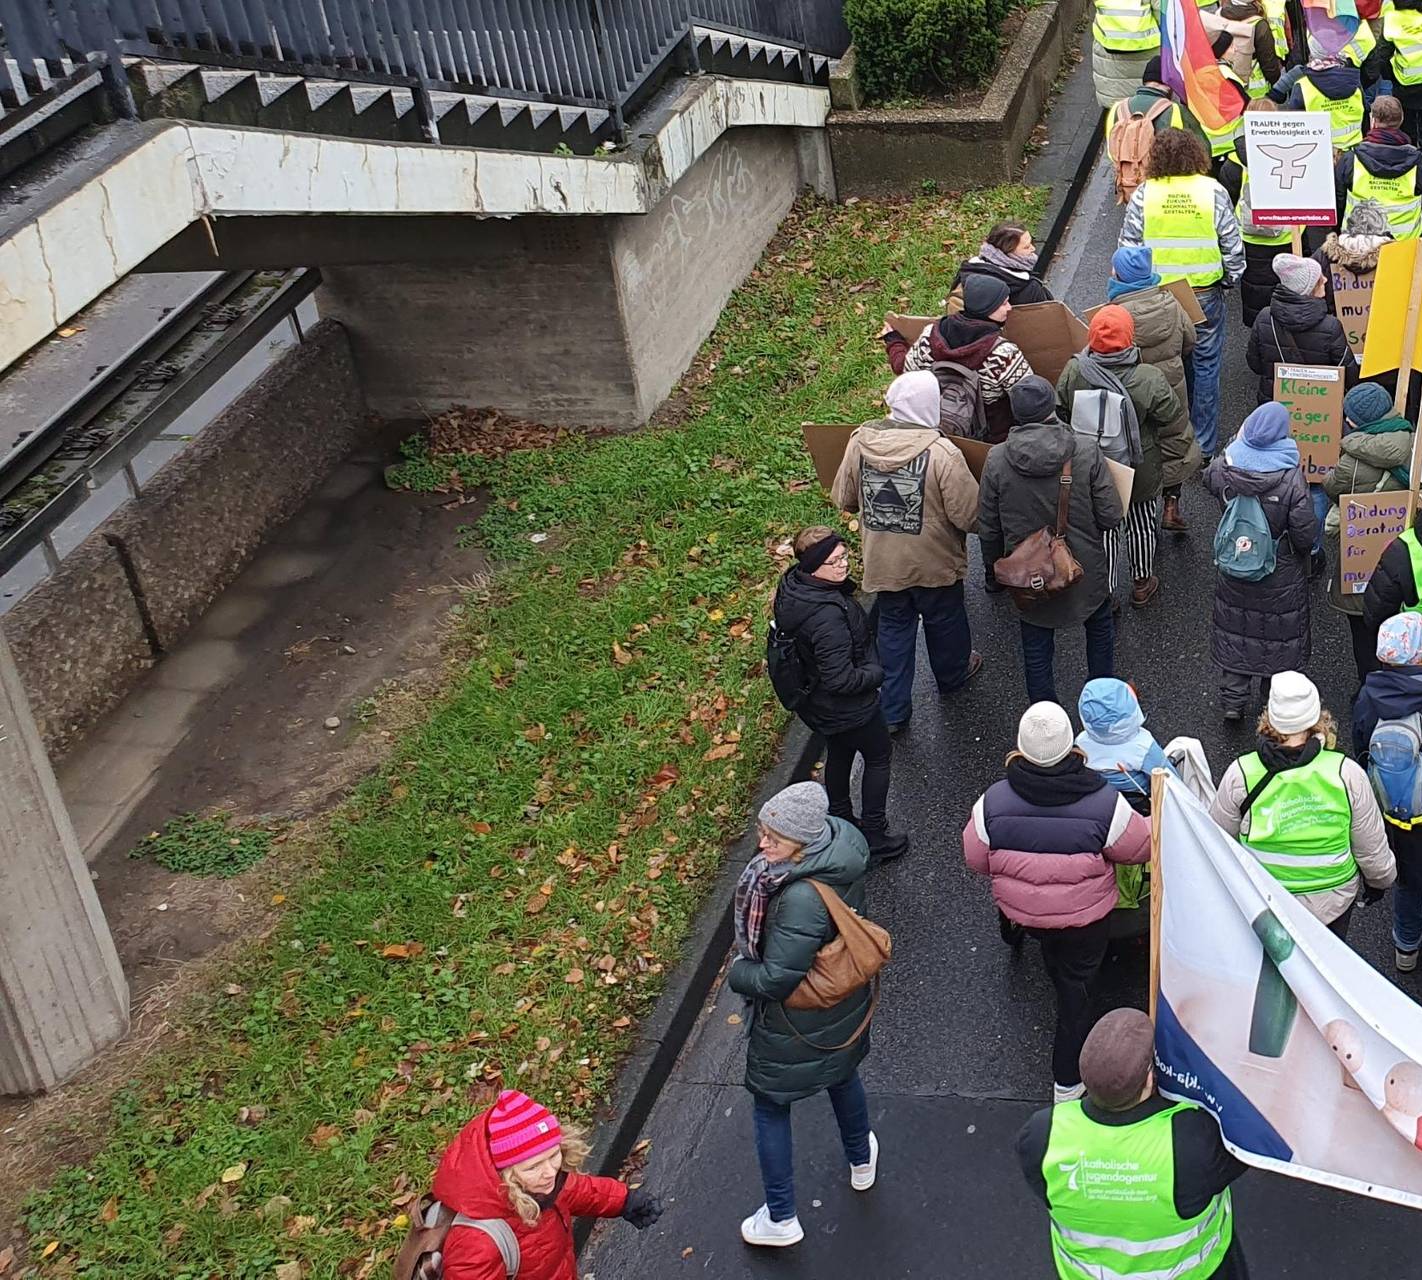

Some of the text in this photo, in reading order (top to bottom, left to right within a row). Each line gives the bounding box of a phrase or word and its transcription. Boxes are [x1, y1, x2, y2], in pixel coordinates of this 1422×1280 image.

[1283, 121, 1306, 129] gegen
[1250, 129, 1310, 137] Erwerbslosigkeit
[1281, 378, 1328, 396] Kleine
[1347, 504, 1407, 521] Bildung
[1347, 545, 1367, 557] für
[1083, 1157, 1141, 1171] katholische
[1085, 1170, 1158, 1186] jugendagentur
